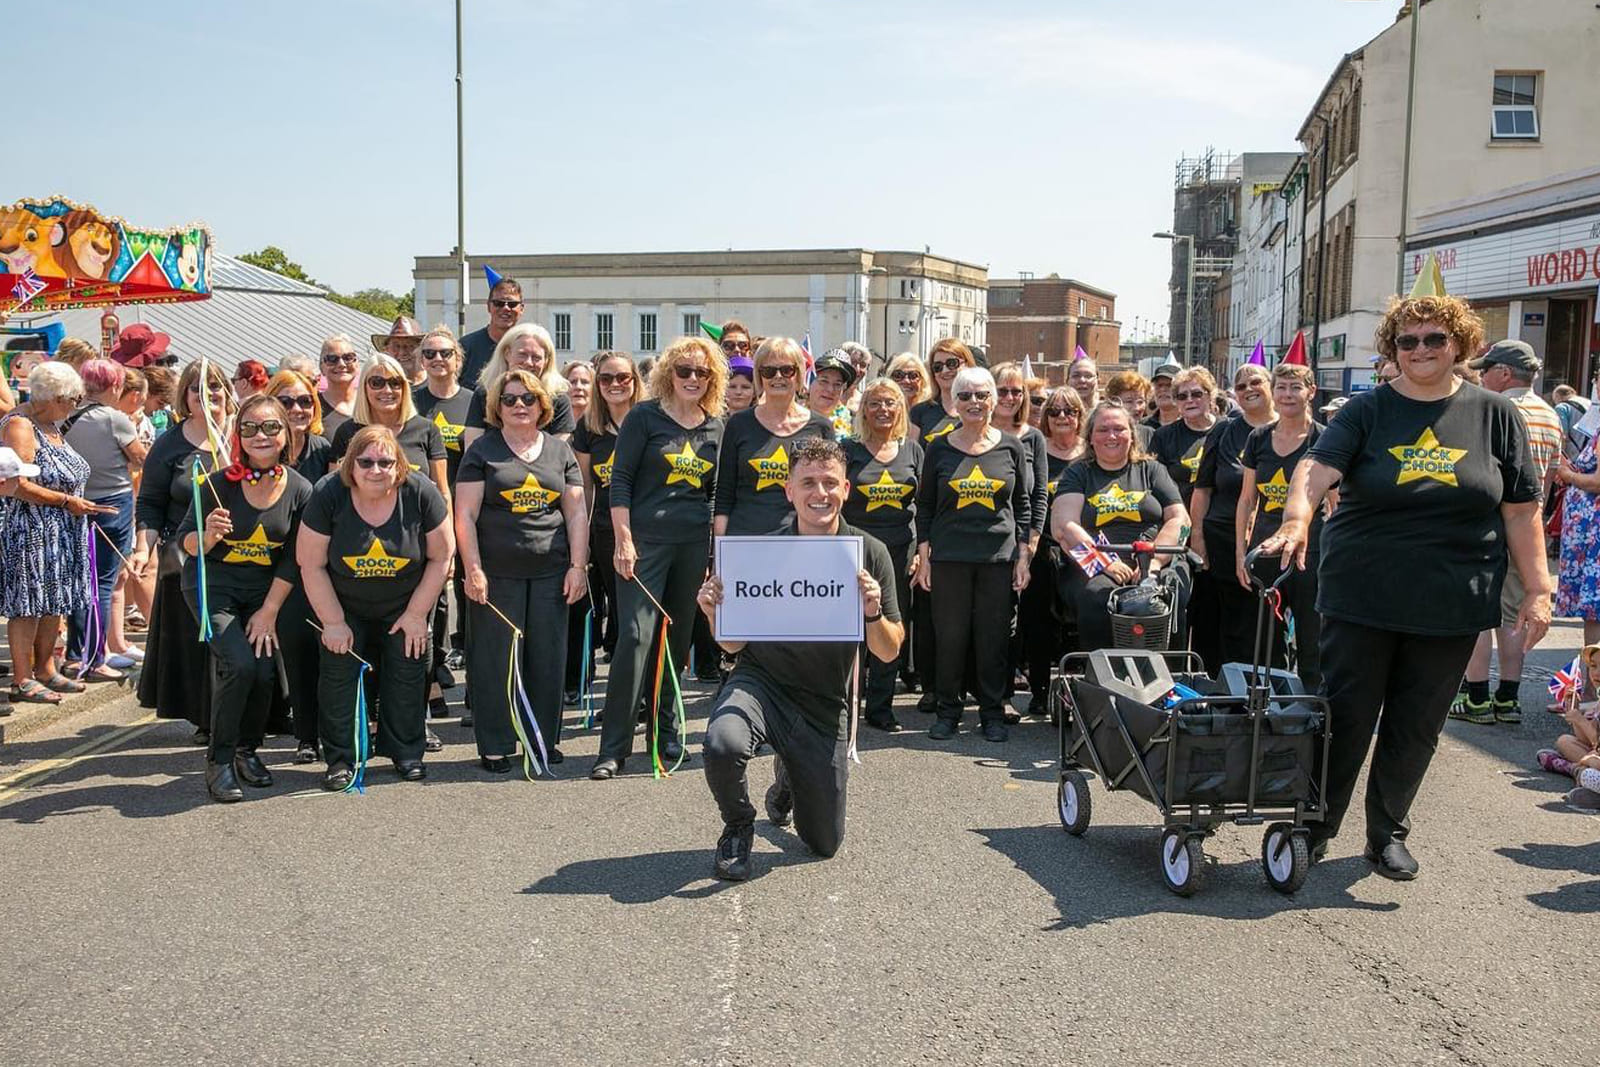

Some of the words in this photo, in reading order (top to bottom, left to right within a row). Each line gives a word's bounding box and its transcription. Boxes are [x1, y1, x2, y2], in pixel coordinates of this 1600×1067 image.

[1527, 247, 1587, 287] WORD
[1403, 448, 1450, 460] ROCK
[676, 457, 705, 471] ROCK
[760, 461, 788, 472] ROC
[1400, 460, 1456, 472] CHOIR
[674, 467, 702, 480] CHOIR
[759, 471, 788, 480] CHOI
[869, 486, 903, 495] ROCK
[958, 481, 995, 490] ROCK
[1264, 486, 1289, 494] ROC
[513, 490, 549, 501] ROCK
[959, 490, 995, 499] CHOIR
[511, 499, 550, 511] CHOIR
[355, 558, 396, 569] ROCK
[736, 580, 783, 598] Rock
[790, 580, 845, 598] Choir
